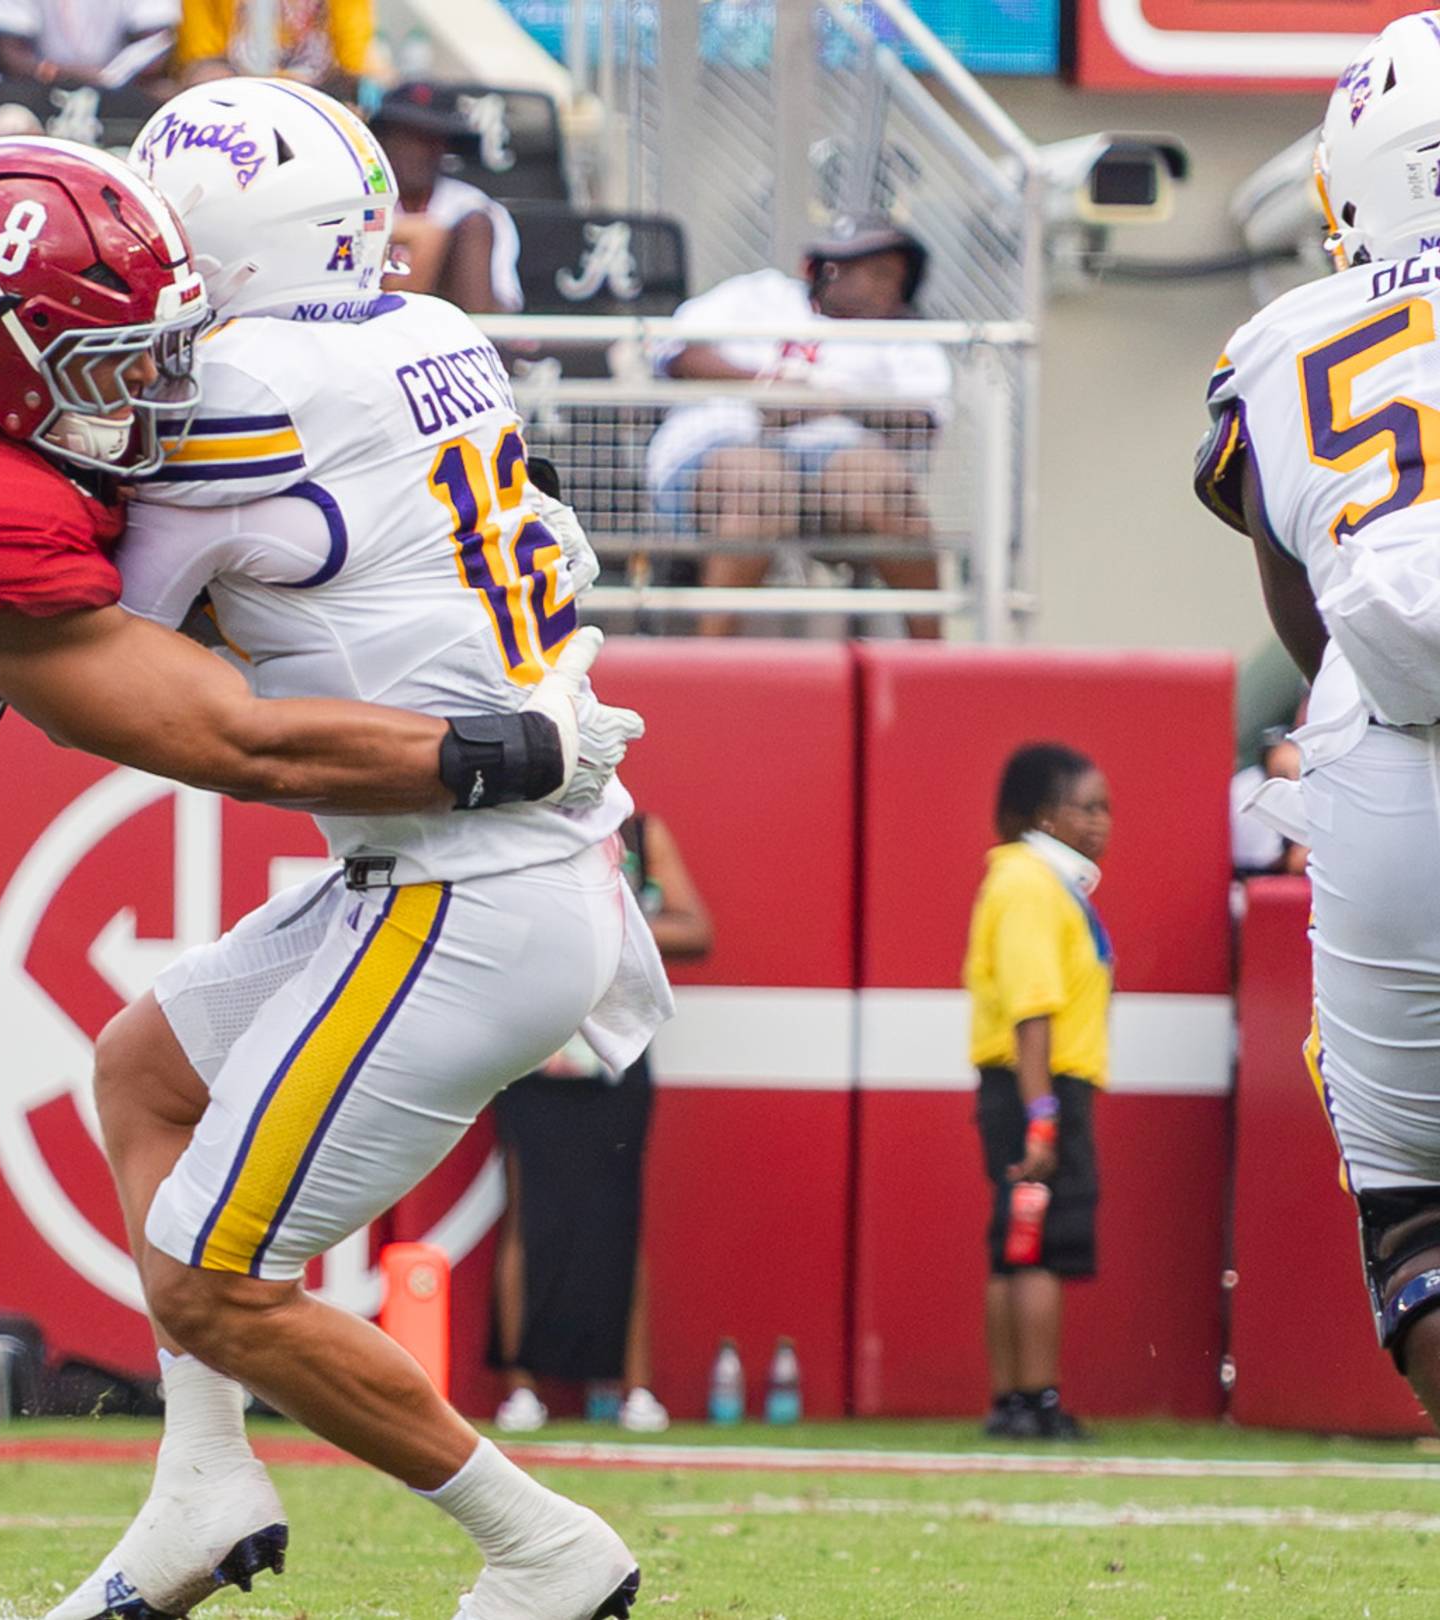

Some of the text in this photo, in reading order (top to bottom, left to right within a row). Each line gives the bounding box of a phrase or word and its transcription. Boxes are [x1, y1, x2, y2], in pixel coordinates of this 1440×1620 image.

[137, 111, 267, 191] Pirates
[555, 221, 642, 300] A
[291, 300, 376, 322] NO QUA
[427, 423, 580, 687] 12
